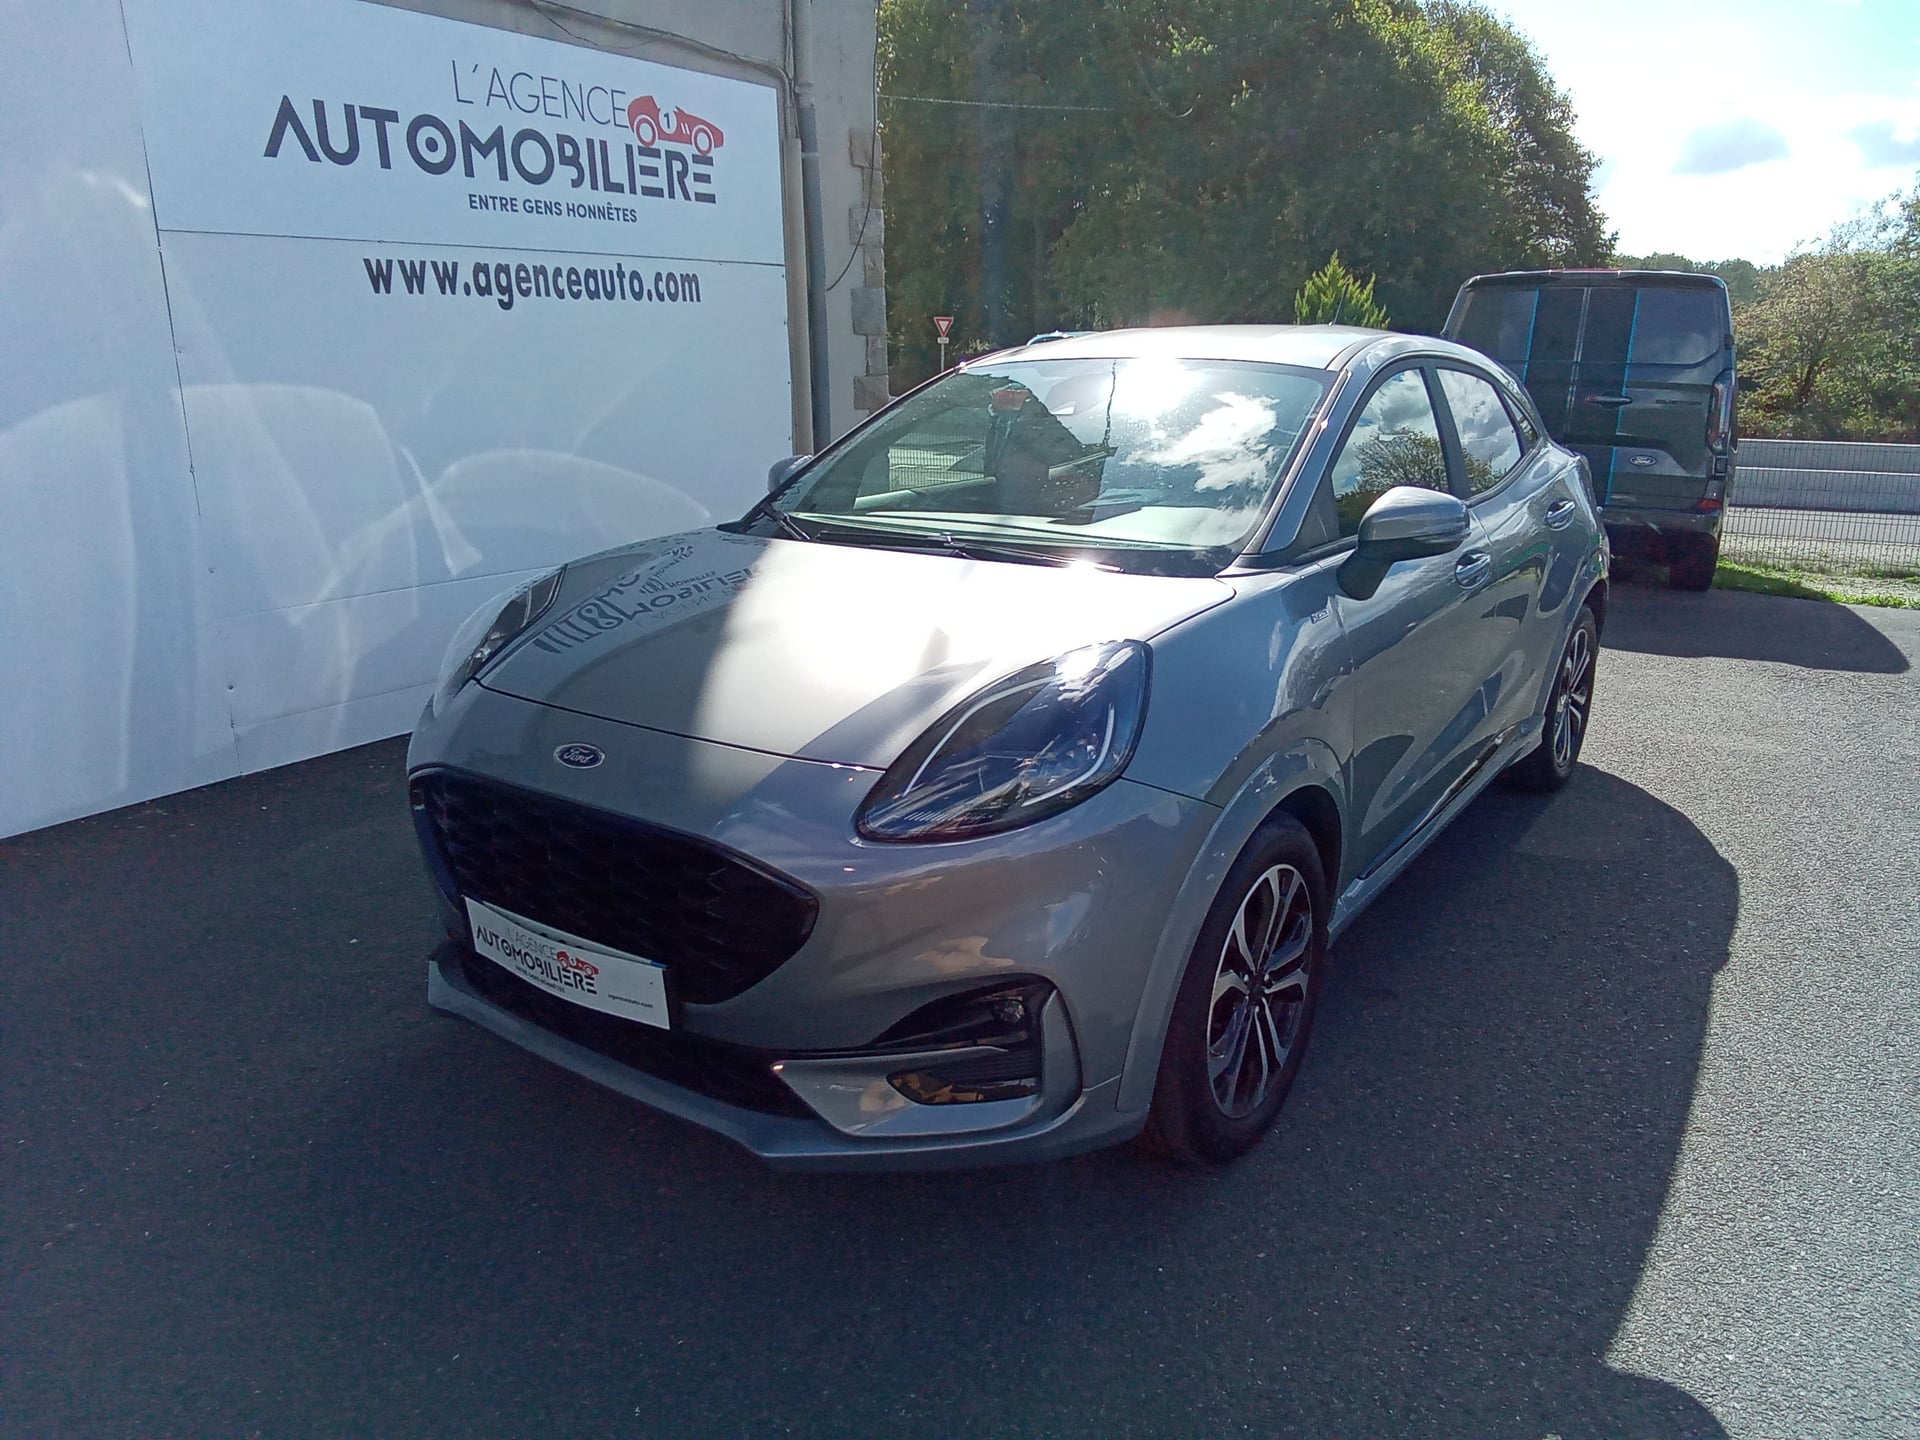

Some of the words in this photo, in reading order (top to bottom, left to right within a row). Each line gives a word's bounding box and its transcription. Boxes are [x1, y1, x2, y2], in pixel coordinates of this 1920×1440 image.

[452, 59, 629, 128] L'AGENCE
[468, 194, 519, 213] ENTRE
[523, 199, 563, 217] GENS
[567, 202, 638, 223] HONNÊTES
[363, 257, 702, 311] www.agenceauto.com
